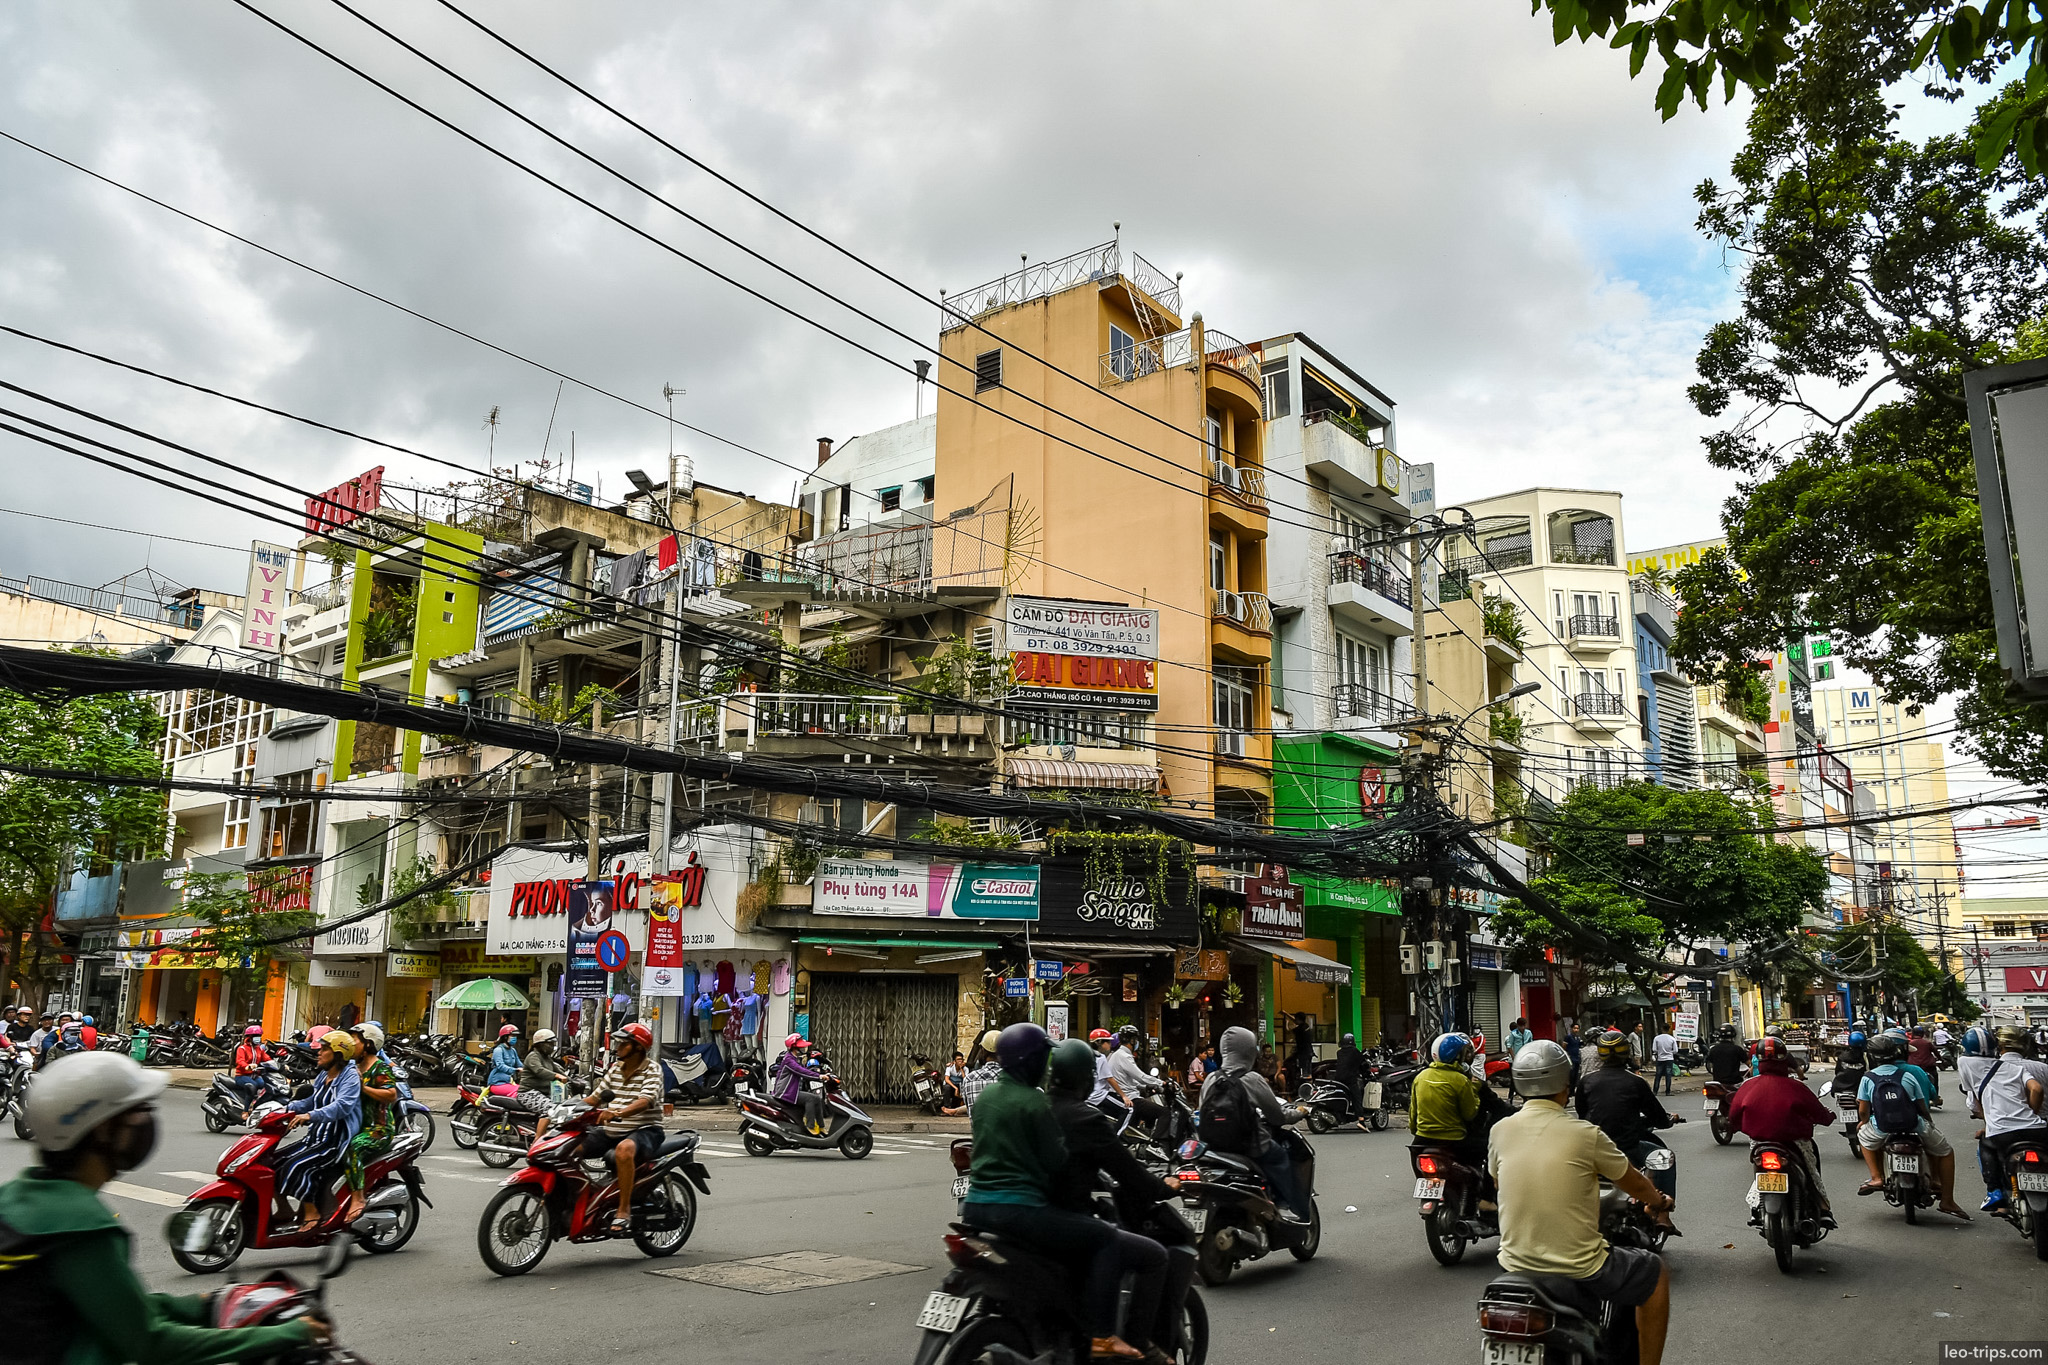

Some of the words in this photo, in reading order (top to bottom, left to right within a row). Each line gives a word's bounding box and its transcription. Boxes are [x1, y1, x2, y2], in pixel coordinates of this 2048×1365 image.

[305, 465, 385, 537] VINH
[257, 546, 271, 564] NHÀ
[247, 566, 282, 647] VINH
[1068, 610, 1095, 628] ĐẠI
[1100, 612, 1150, 628] GIANG
[1056, 627, 1070, 637] 441
[1145, 634, 1150, 642] 3
[1027, 639, 1049, 649] ĐT:
[1053, 641, 1068, 650] 08
[1073, 642, 1102, 652] 3929
[1107, 644, 1137, 654] 2193
[1015, 651, 1062, 686] ĐẠI
[1071, 656, 1154, 689] GIANG
[1044, 691, 1067, 701] THẮNG
[1093, 695, 1102, 704] 14)
[1120, 697, 1135, 705] 3929
[1136, 698, 1151, 706] 2193
[1852, 691, 1870, 708] M
[823, 863, 838, 876] Bán
[839, 866, 854, 879] phụ
[856, 866, 873, 879] tùng
[875, 867, 899, 878] Honda
[823, 880, 849, 899] Phụ
[854, 882, 886, 899] tùng
[892, 883, 919, 898] 14A
[987, 881, 1031, 895] Castrol
[508, 877, 582, 917] PHON
[1077, 890, 1155, 926] Saigon
[1252, 903, 1278, 925] TRÂM
[1278, 902, 1303, 928] ANH
[512, 941, 524, 950] CAO
[525, 937, 545, 949] THẮNG
[691, 935, 703, 944] 323
[704, 934, 715, 943] 180
[395, 956, 423, 967] GIẶT
[1524, 969, 1544, 977] Julia
[1884, 1092, 1898, 1100] ila
[2022, 1174, 2047, 1182] 56-P2
[2024, 1182, 2048, 1190] 7095
[1418, 1189, 1439, 1197] 7559
[1760, 1183, 1784, 1191] 5820
[1489, 1343, 1535, 1364] 51-T2
